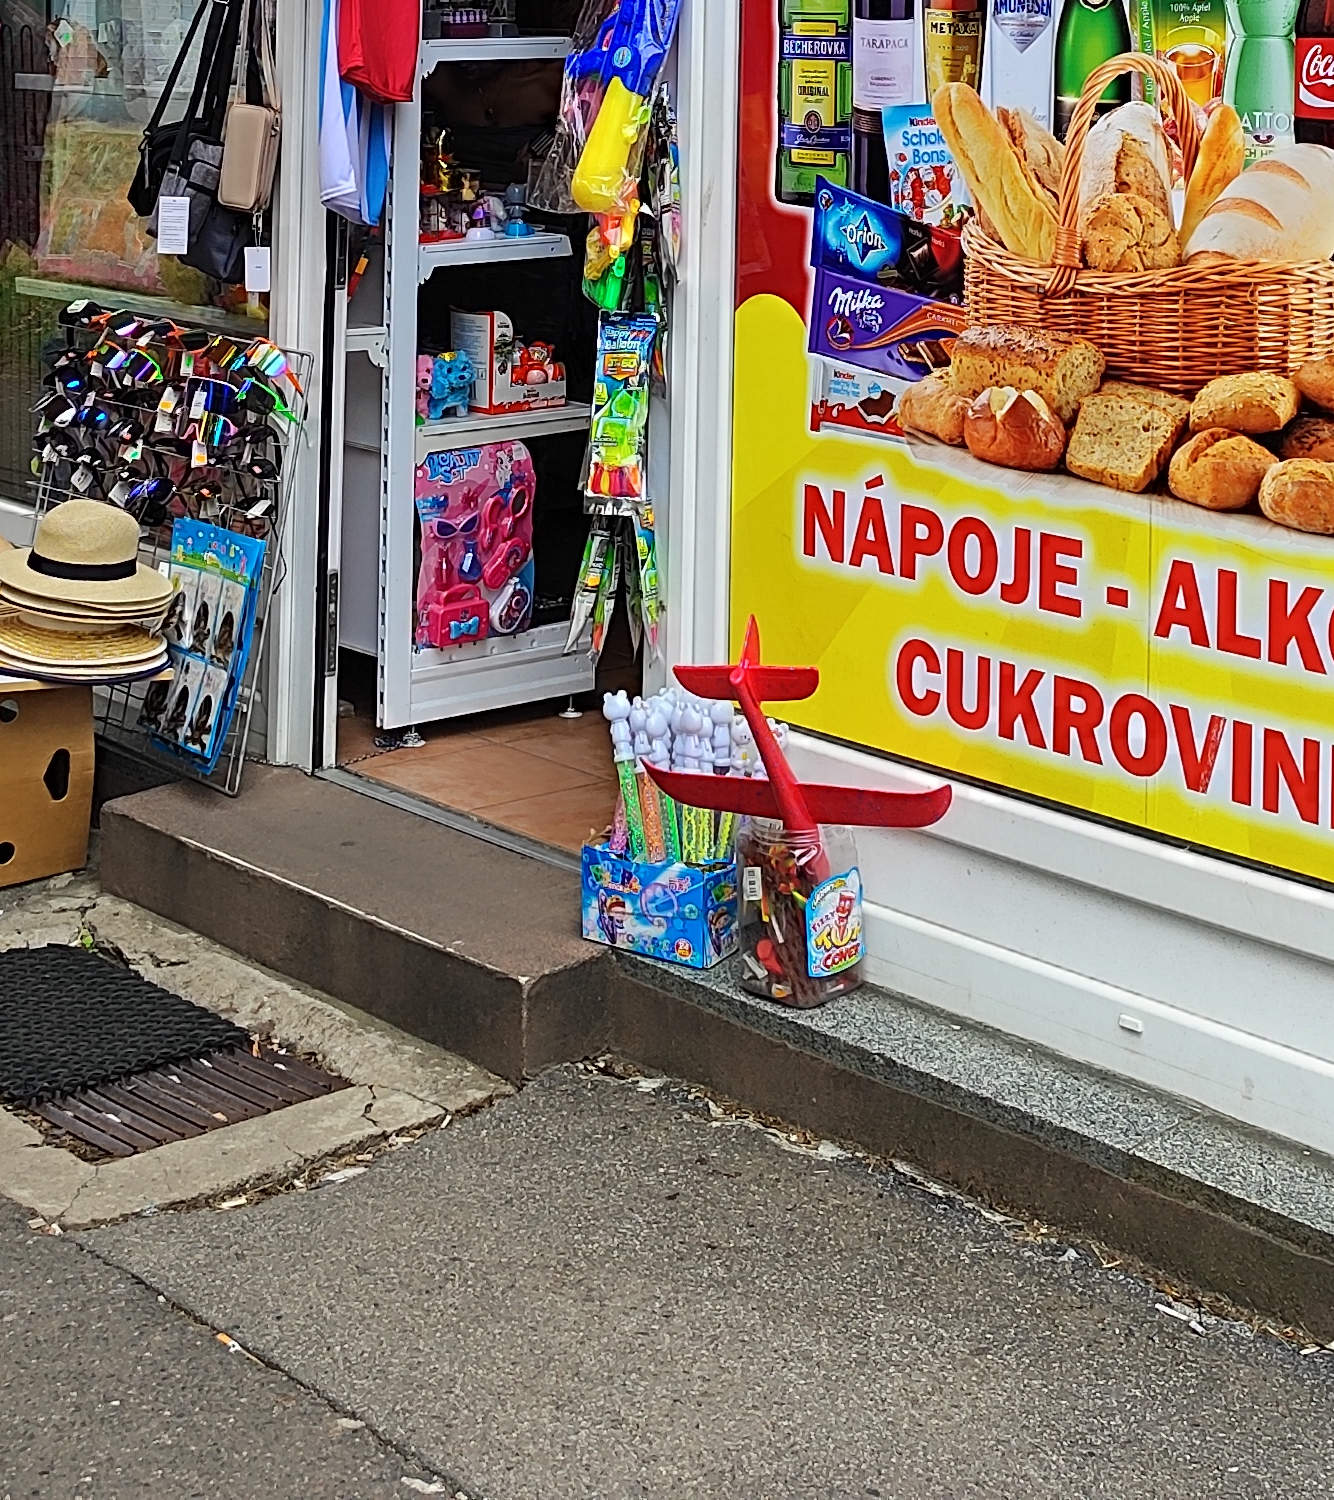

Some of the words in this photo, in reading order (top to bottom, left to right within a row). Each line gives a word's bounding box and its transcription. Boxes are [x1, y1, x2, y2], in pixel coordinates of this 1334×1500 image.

[1170, 3, 1190, 12] 100%
[1179, 13, 1200, 23] Apple
[930, 22, 978, 34] METAXA
[783, 40, 846, 55] BECHEROVKA
[1241, 112, 1291, 132] ATTO
[902, 129, 945, 146] Schok
[913, 149, 945, 164] Bons
[847, 224, 882, 249] Orion
[828, 286, 885, 317] Milka
[833, 369, 856, 380] kinder
[803, 475, 1083, 619] NÁPOJE
[1106, 586, 1128, 608] -
